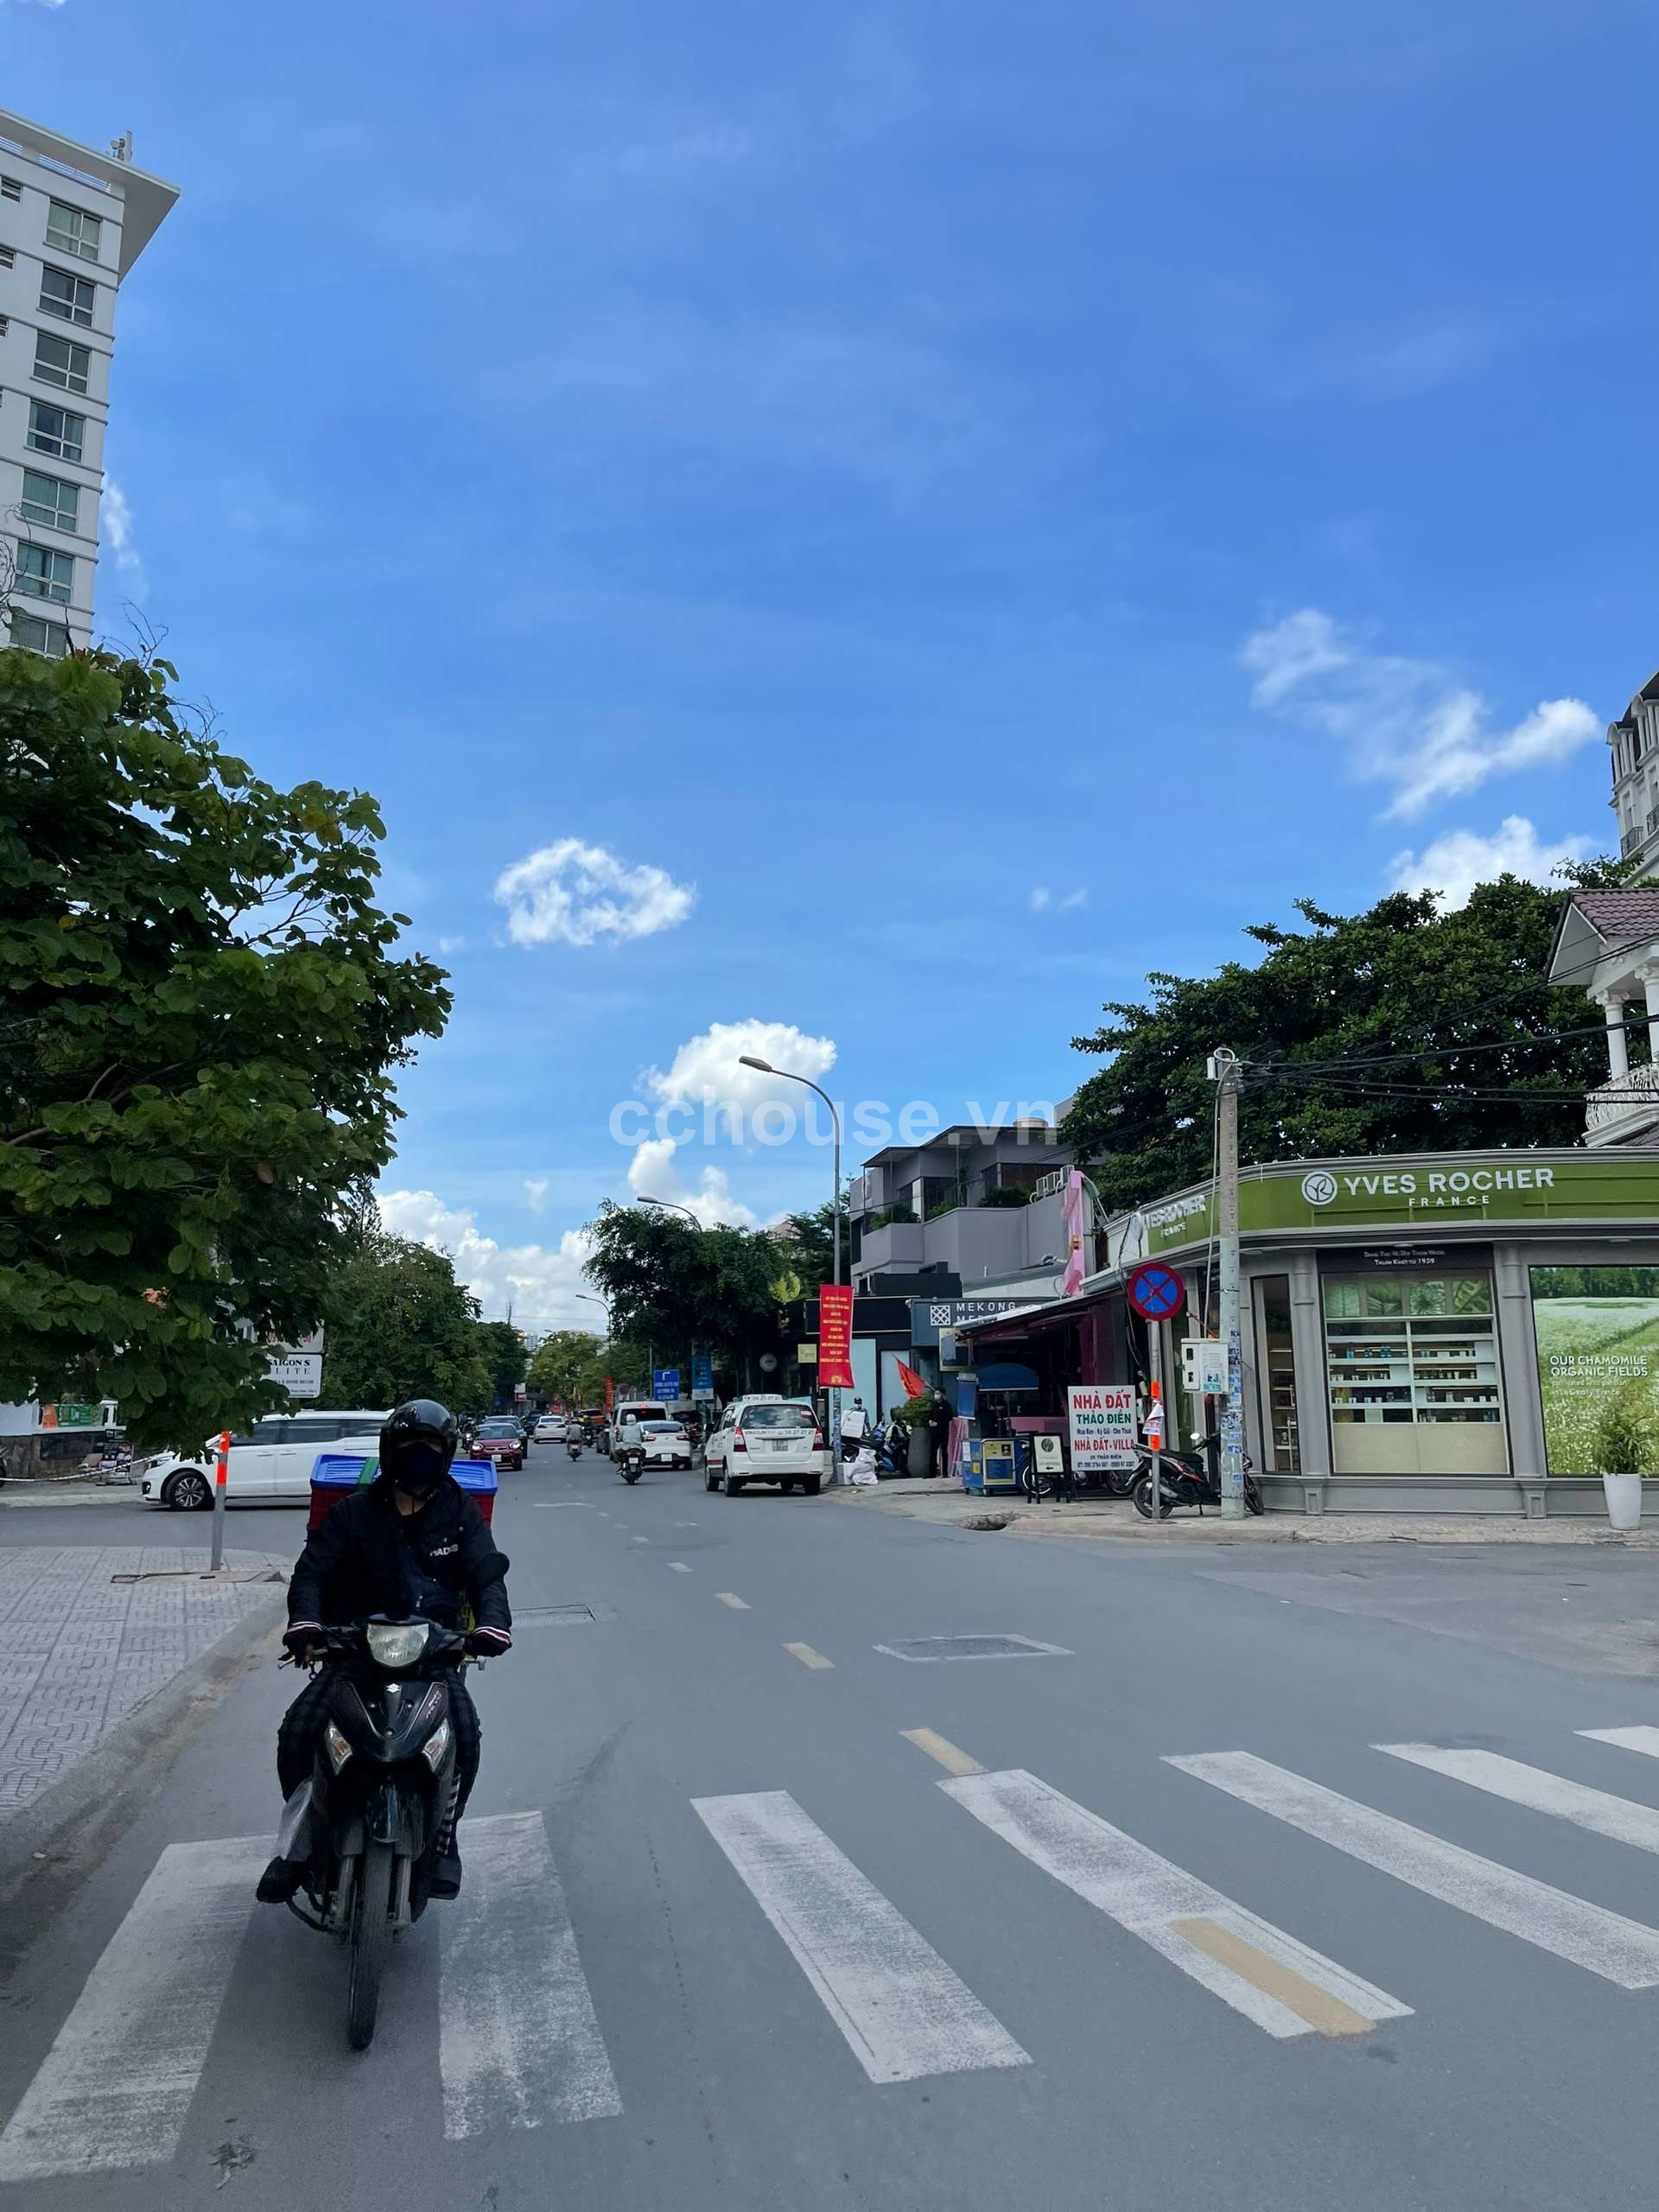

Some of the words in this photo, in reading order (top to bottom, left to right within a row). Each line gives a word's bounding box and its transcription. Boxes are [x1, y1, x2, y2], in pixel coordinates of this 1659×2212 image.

[1344, 1174, 1416, 1196] YVES
[1428, 1168, 1554, 1193] ROCHER
[1408, 1195, 1489, 1207] FRANCE
[956, 1302, 1016, 1312] MEKONG
[1549, 1356, 1575, 1365] OUR
[1578, 1356, 1648, 1365] CHAMOMILE
[1551, 1367, 1605, 1376] ORGANIC
[1608, 1367, 1649, 1376] FIELDS
[1073, 1390, 1102, 1409] NHÀ
[1106, 1389, 1131, 1409] ĐẤT
[1074, 1436, 1091, 1451] NHÀ
[1093, 1435, 1109, 1451] ĐẤT
[1113, 1439, 1135, 1451] VILLA
